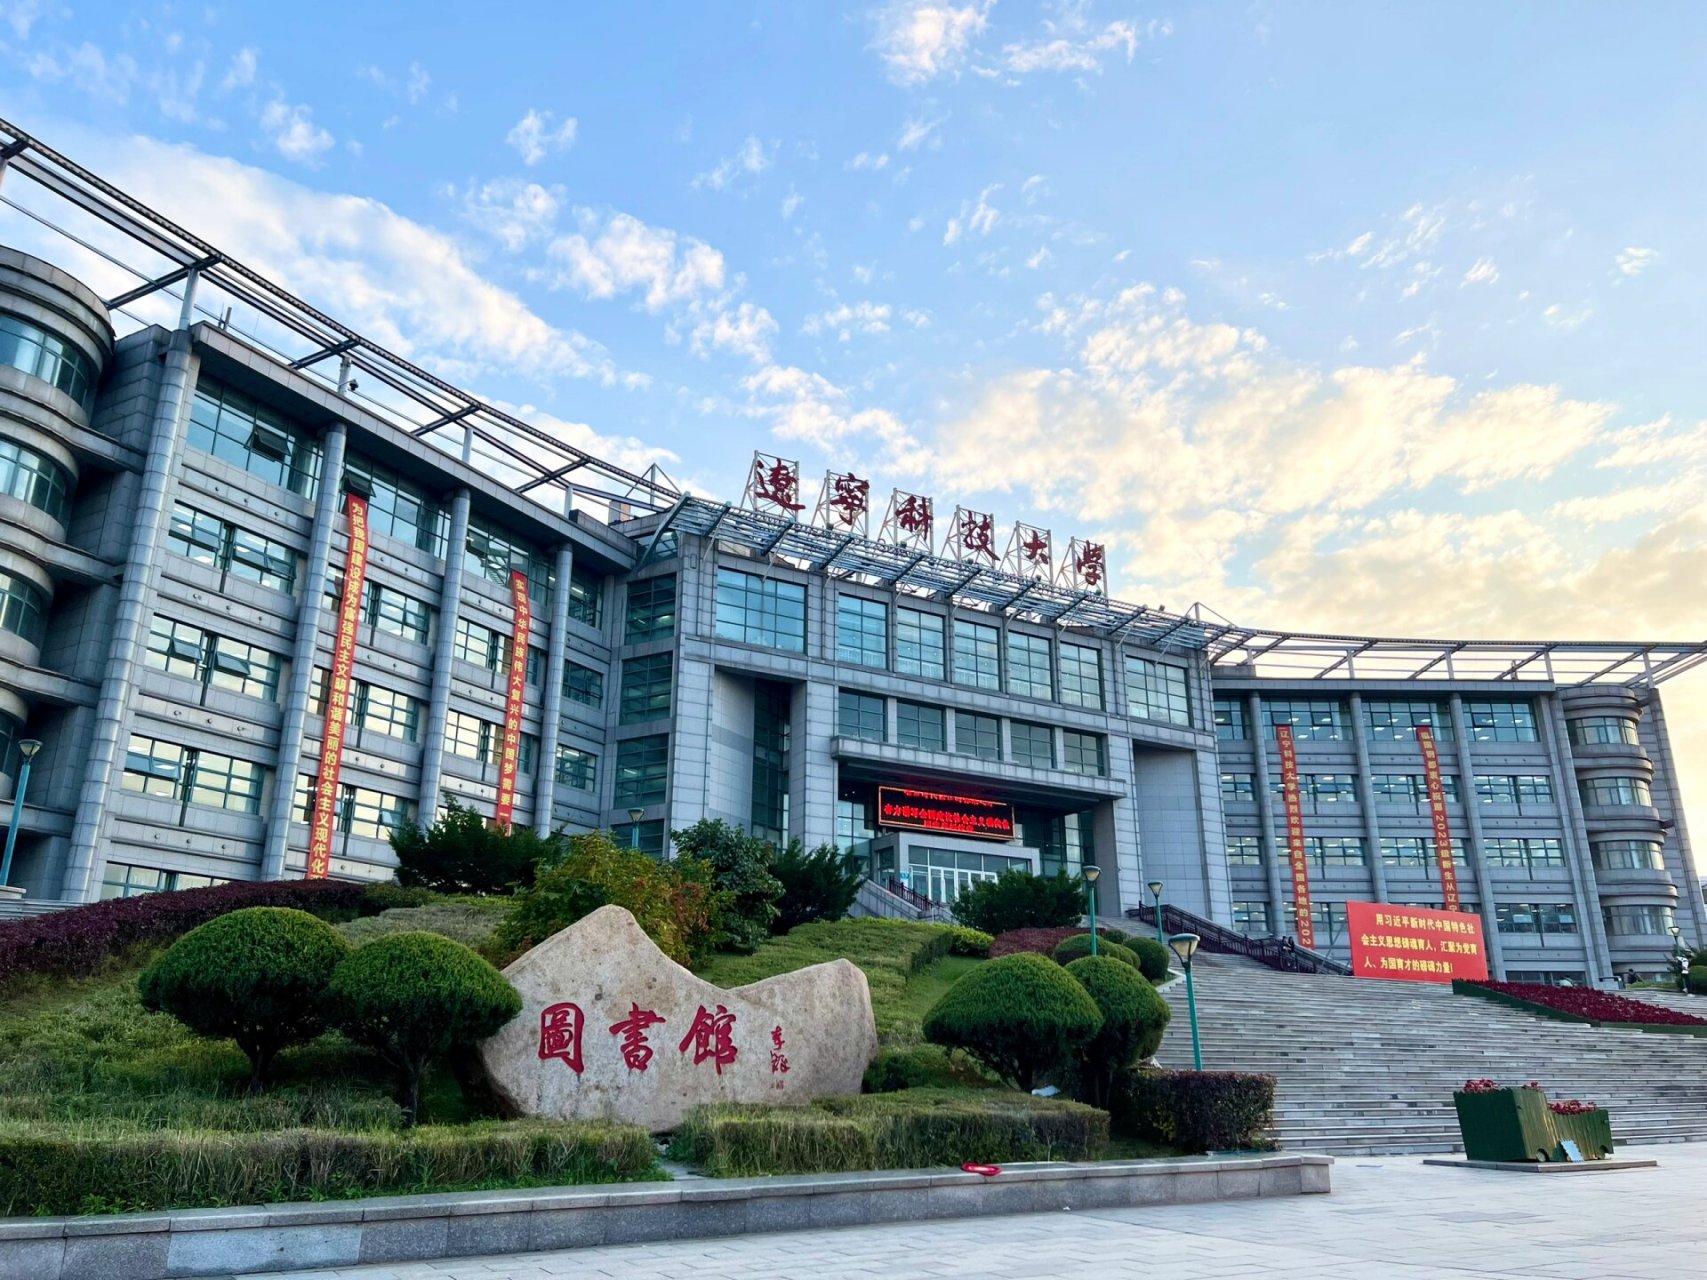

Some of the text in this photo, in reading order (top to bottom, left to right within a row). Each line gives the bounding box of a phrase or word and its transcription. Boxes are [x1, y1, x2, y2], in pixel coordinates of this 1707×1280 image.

[1280, 731, 1312, 947] 辽宁科技大学热烈欢迎来自全国各地的202
[1376, 913, 1475, 934] 用习近平新时代中国特色社
